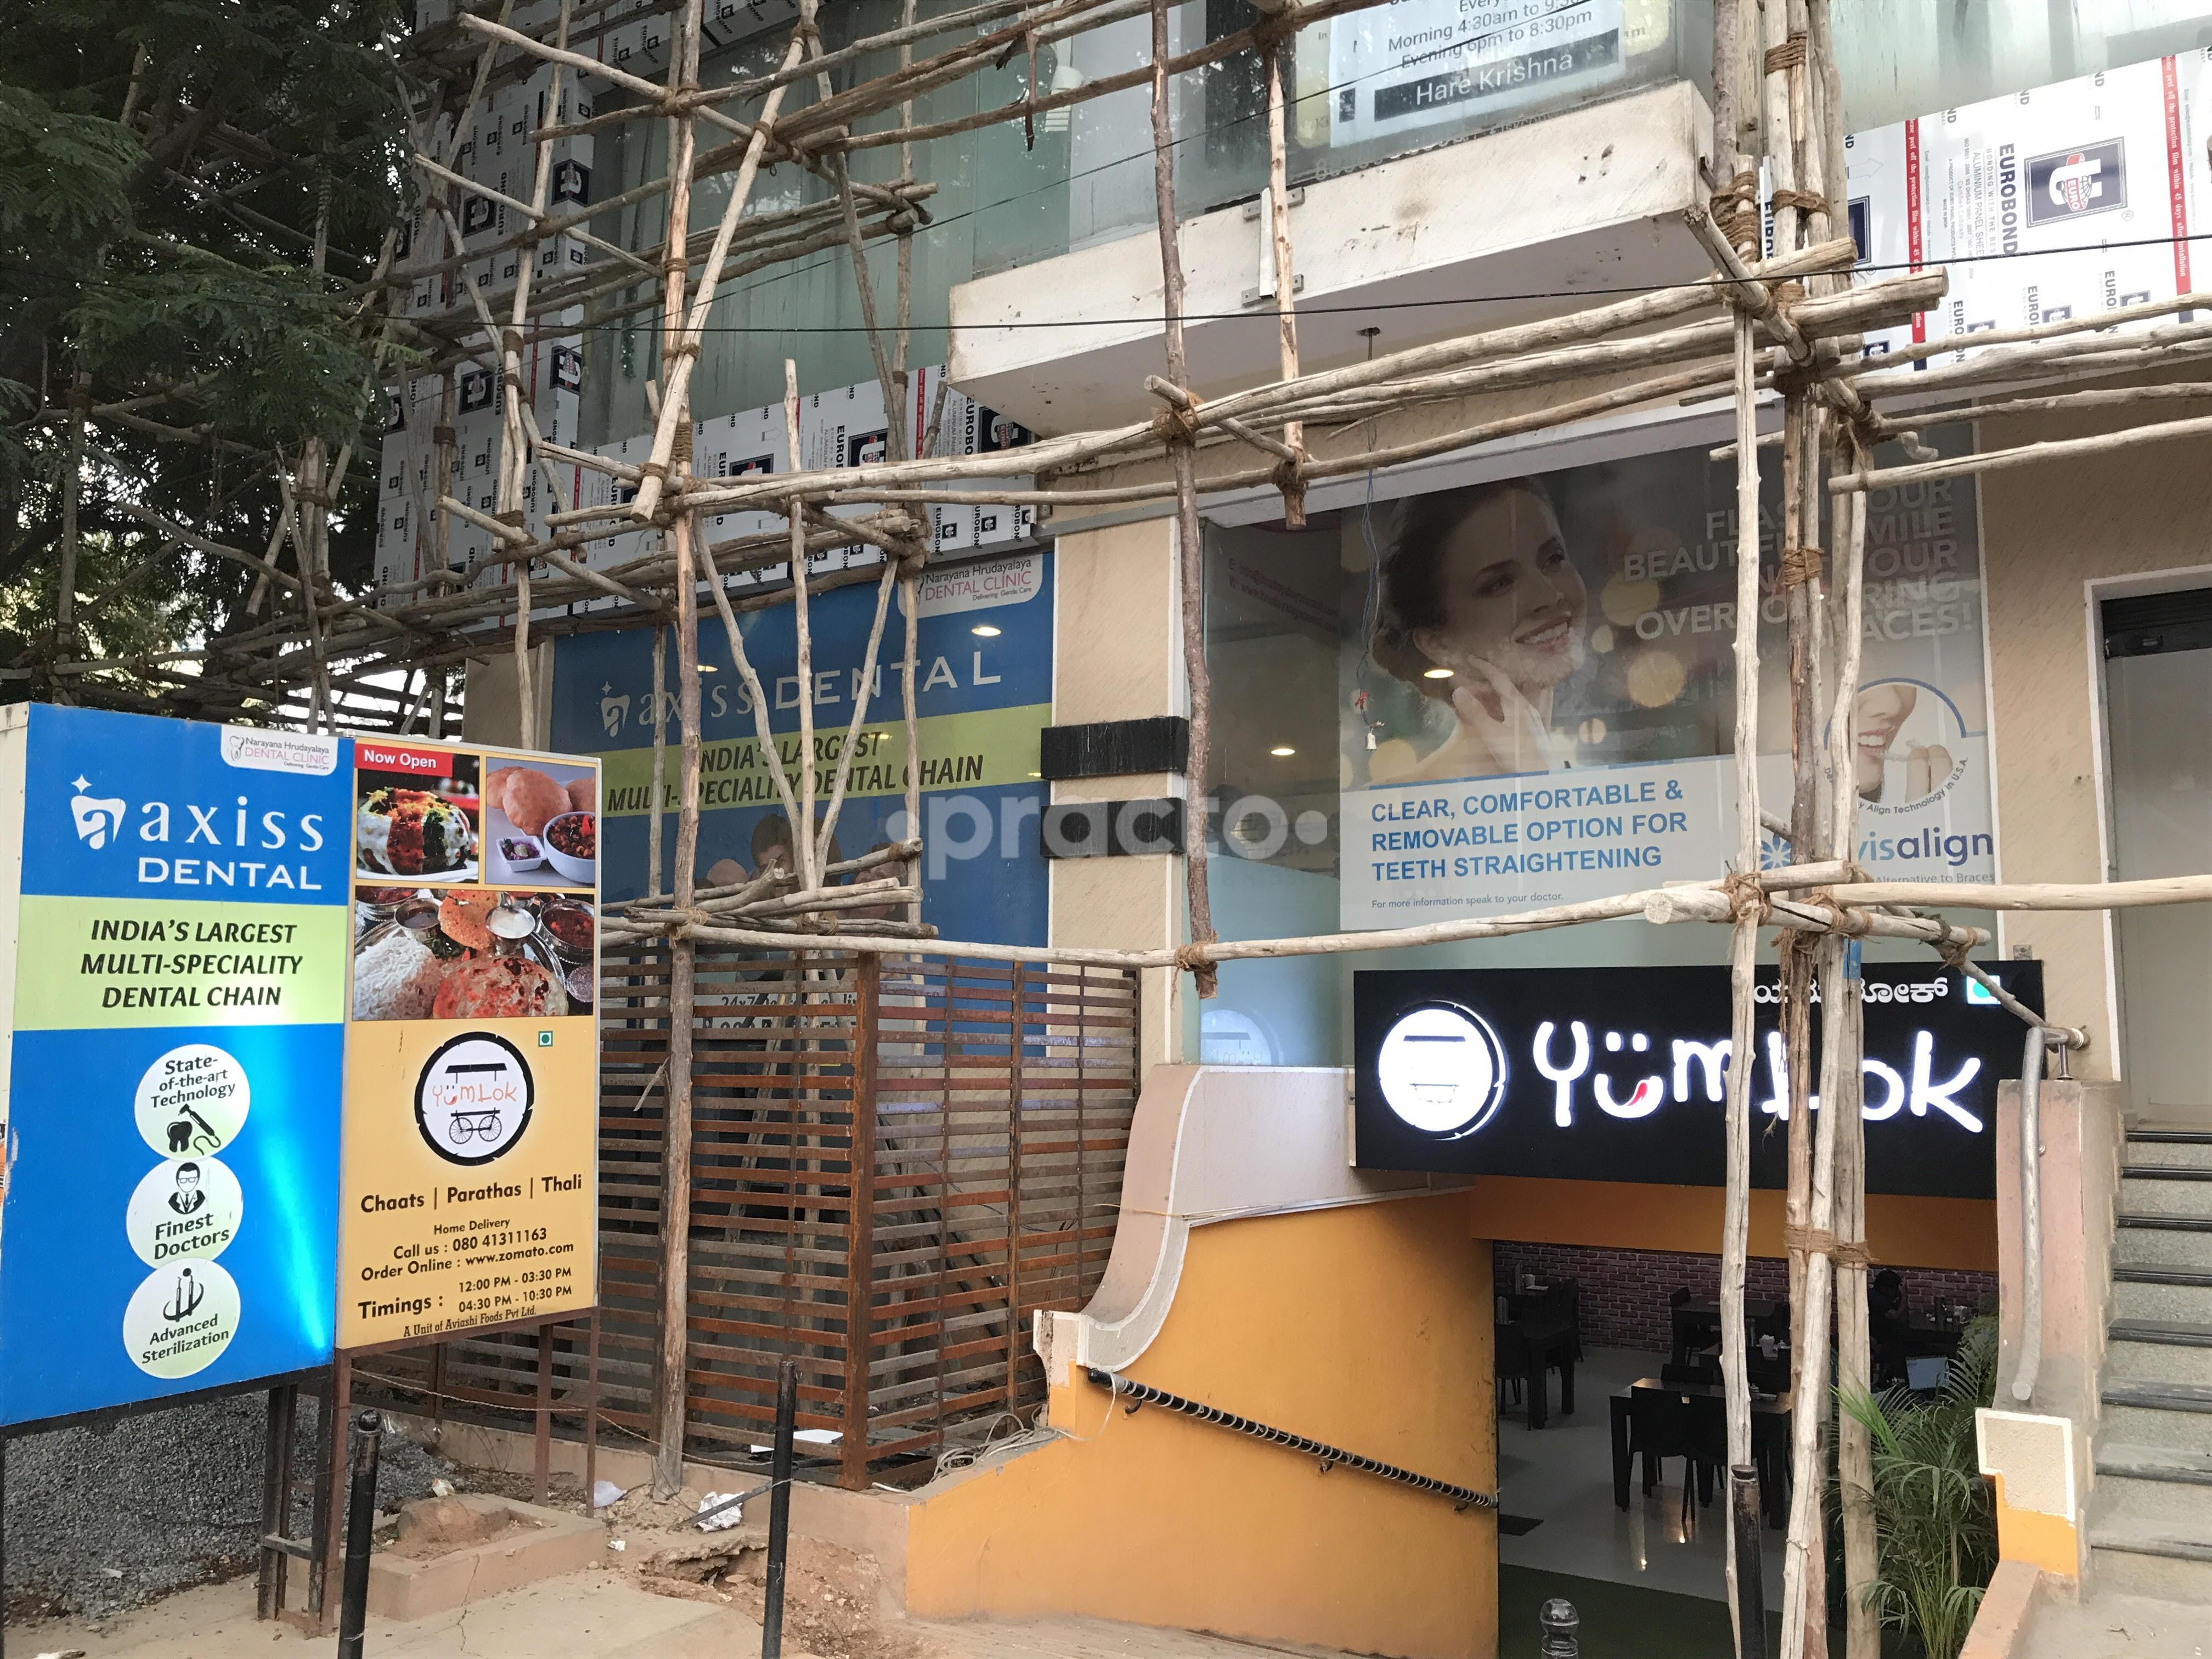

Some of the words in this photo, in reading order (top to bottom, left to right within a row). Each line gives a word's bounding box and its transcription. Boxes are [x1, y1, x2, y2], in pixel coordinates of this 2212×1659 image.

[1389, 25, 1453, 52] Morning
[1457, 9, 1518, 32] 4:30am
[1523, 4, 1539, 16] to
[1401, 44, 1462, 69] Evening
[1508, 29, 1524, 42] to
[1530, 11, 1592, 37] 8:30pm
[1417, 79, 1471, 105] Hare
[1480, 54, 1573, 90] Krishna
[2168, 116, 2177, 149] protection
[1973, 152, 1983, 200] ALUMINIUM
[1974, 201, 1983, 230] PANEL
[2000, 143, 2018, 256] EUROBOND
[2174, 203, 2182, 219] days
[1976, 231, 1985, 256] SHEE
[2177, 239, 2187, 277] installation
[964, 397, 975, 455] EUROBO
[1866, 504, 1955, 545] MILE
[926, 569, 969, 584] Narayana
[972, 559, 1031, 577] Hrudayalaya
[1867, 539, 1958, 578] OUR
[926, 580, 980, 601] DENTAL
[983, 571, 1032, 591] CLINIC
[245, 747, 290, 761] DENTAL
[292, 752, 329, 765] CLINIC
[246, 737, 282, 749] Narayana
[284, 741, 329, 755] Hrudayalaya
[364, 749, 397, 765] Now
[399, 753, 437, 770] Open
[781, 731, 883, 765] LARGST
[1372, 799, 1455, 822] CLEAR,
[1463, 782, 1656, 816] COMFORTABLE
[1664, 779, 1683, 800] &
[1867, 804, 1891, 815] Align
[1894, 789, 1946, 814] Technology
[1944, 782, 1955, 791] in
[140, 796, 324, 851] axiss
[1372, 823, 1519, 851] REMOVABLE
[1526, 816, 1623, 843] OPTION
[1632, 812, 1688, 835] FOR
[138, 857, 322, 890] DENTAL
[1372, 858, 1446, 881] TEETH
[1454, 846, 1662, 877] STRAIGHTENING
[1956, 872, 1995, 883] Braces
[1372, 900, 1386, 909] For
[1413, 895, 1463, 907] information
[1465, 895, 1492, 907] speak
[1494, 896, 1504, 904] to
[1506, 894, 1527, 906] your
[1530, 891, 1564, 902] doctor.
[195, 922, 297, 944] LARGEST
[81, 953, 303, 975] MULTI-SPECIALITY
[102, 986, 200, 1008] DENTAL
[207, 986, 281, 1006] CHAIN
[159, 1069, 228, 1092] of-the-art
[165, 1057, 218, 1075] State-
[150, 1084, 235, 1108] Technology
[361, 1193, 425, 1214] Chaats
[447, 1182, 522, 1203] Parathas
[541, 1174, 582, 1193] Thali
[155, 1213, 213, 1240] Finest
[434, 1224, 465, 1235] Home
[469, 1218, 510, 1232] Delivery
[154, 1228, 229, 1260] Doctors
[394, 1244, 420, 1260] Call
[425, 1244, 439, 1255] us
[453, 1236, 478, 1252] 080
[482, 1227, 547, 1247] 41311163
[361, 1265, 403, 1281] Order
[408, 1260, 453, 1274] Online
[466, 1243, 574, 1266] www.zomato.com
[459, 1277, 490, 1293] 12:00
[494, 1276, 511, 1288] PM
[522, 1269, 552, 1284] 03:30
[556, 1267, 572, 1279] PM
[358, 1295, 432, 1319] Timings
[459, 1297, 491, 1312] 04:30
[495, 1294, 512, 1306] PM
[523, 1287, 552, 1302] 10:30
[556, 1285, 572, 1296] PM
[149, 1314, 218, 1345] Advanced
[403, 1327, 411, 1338] A
[414, 1321, 433, 1335] Unit
[435, 1322, 443, 1333] of
[480, 1310, 503, 1324] Foods
[505, 1308, 519, 1320] Pvt
[521, 1306, 537, 1317] Ltd.
[142, 1329, 229, 1364] Sterilization
